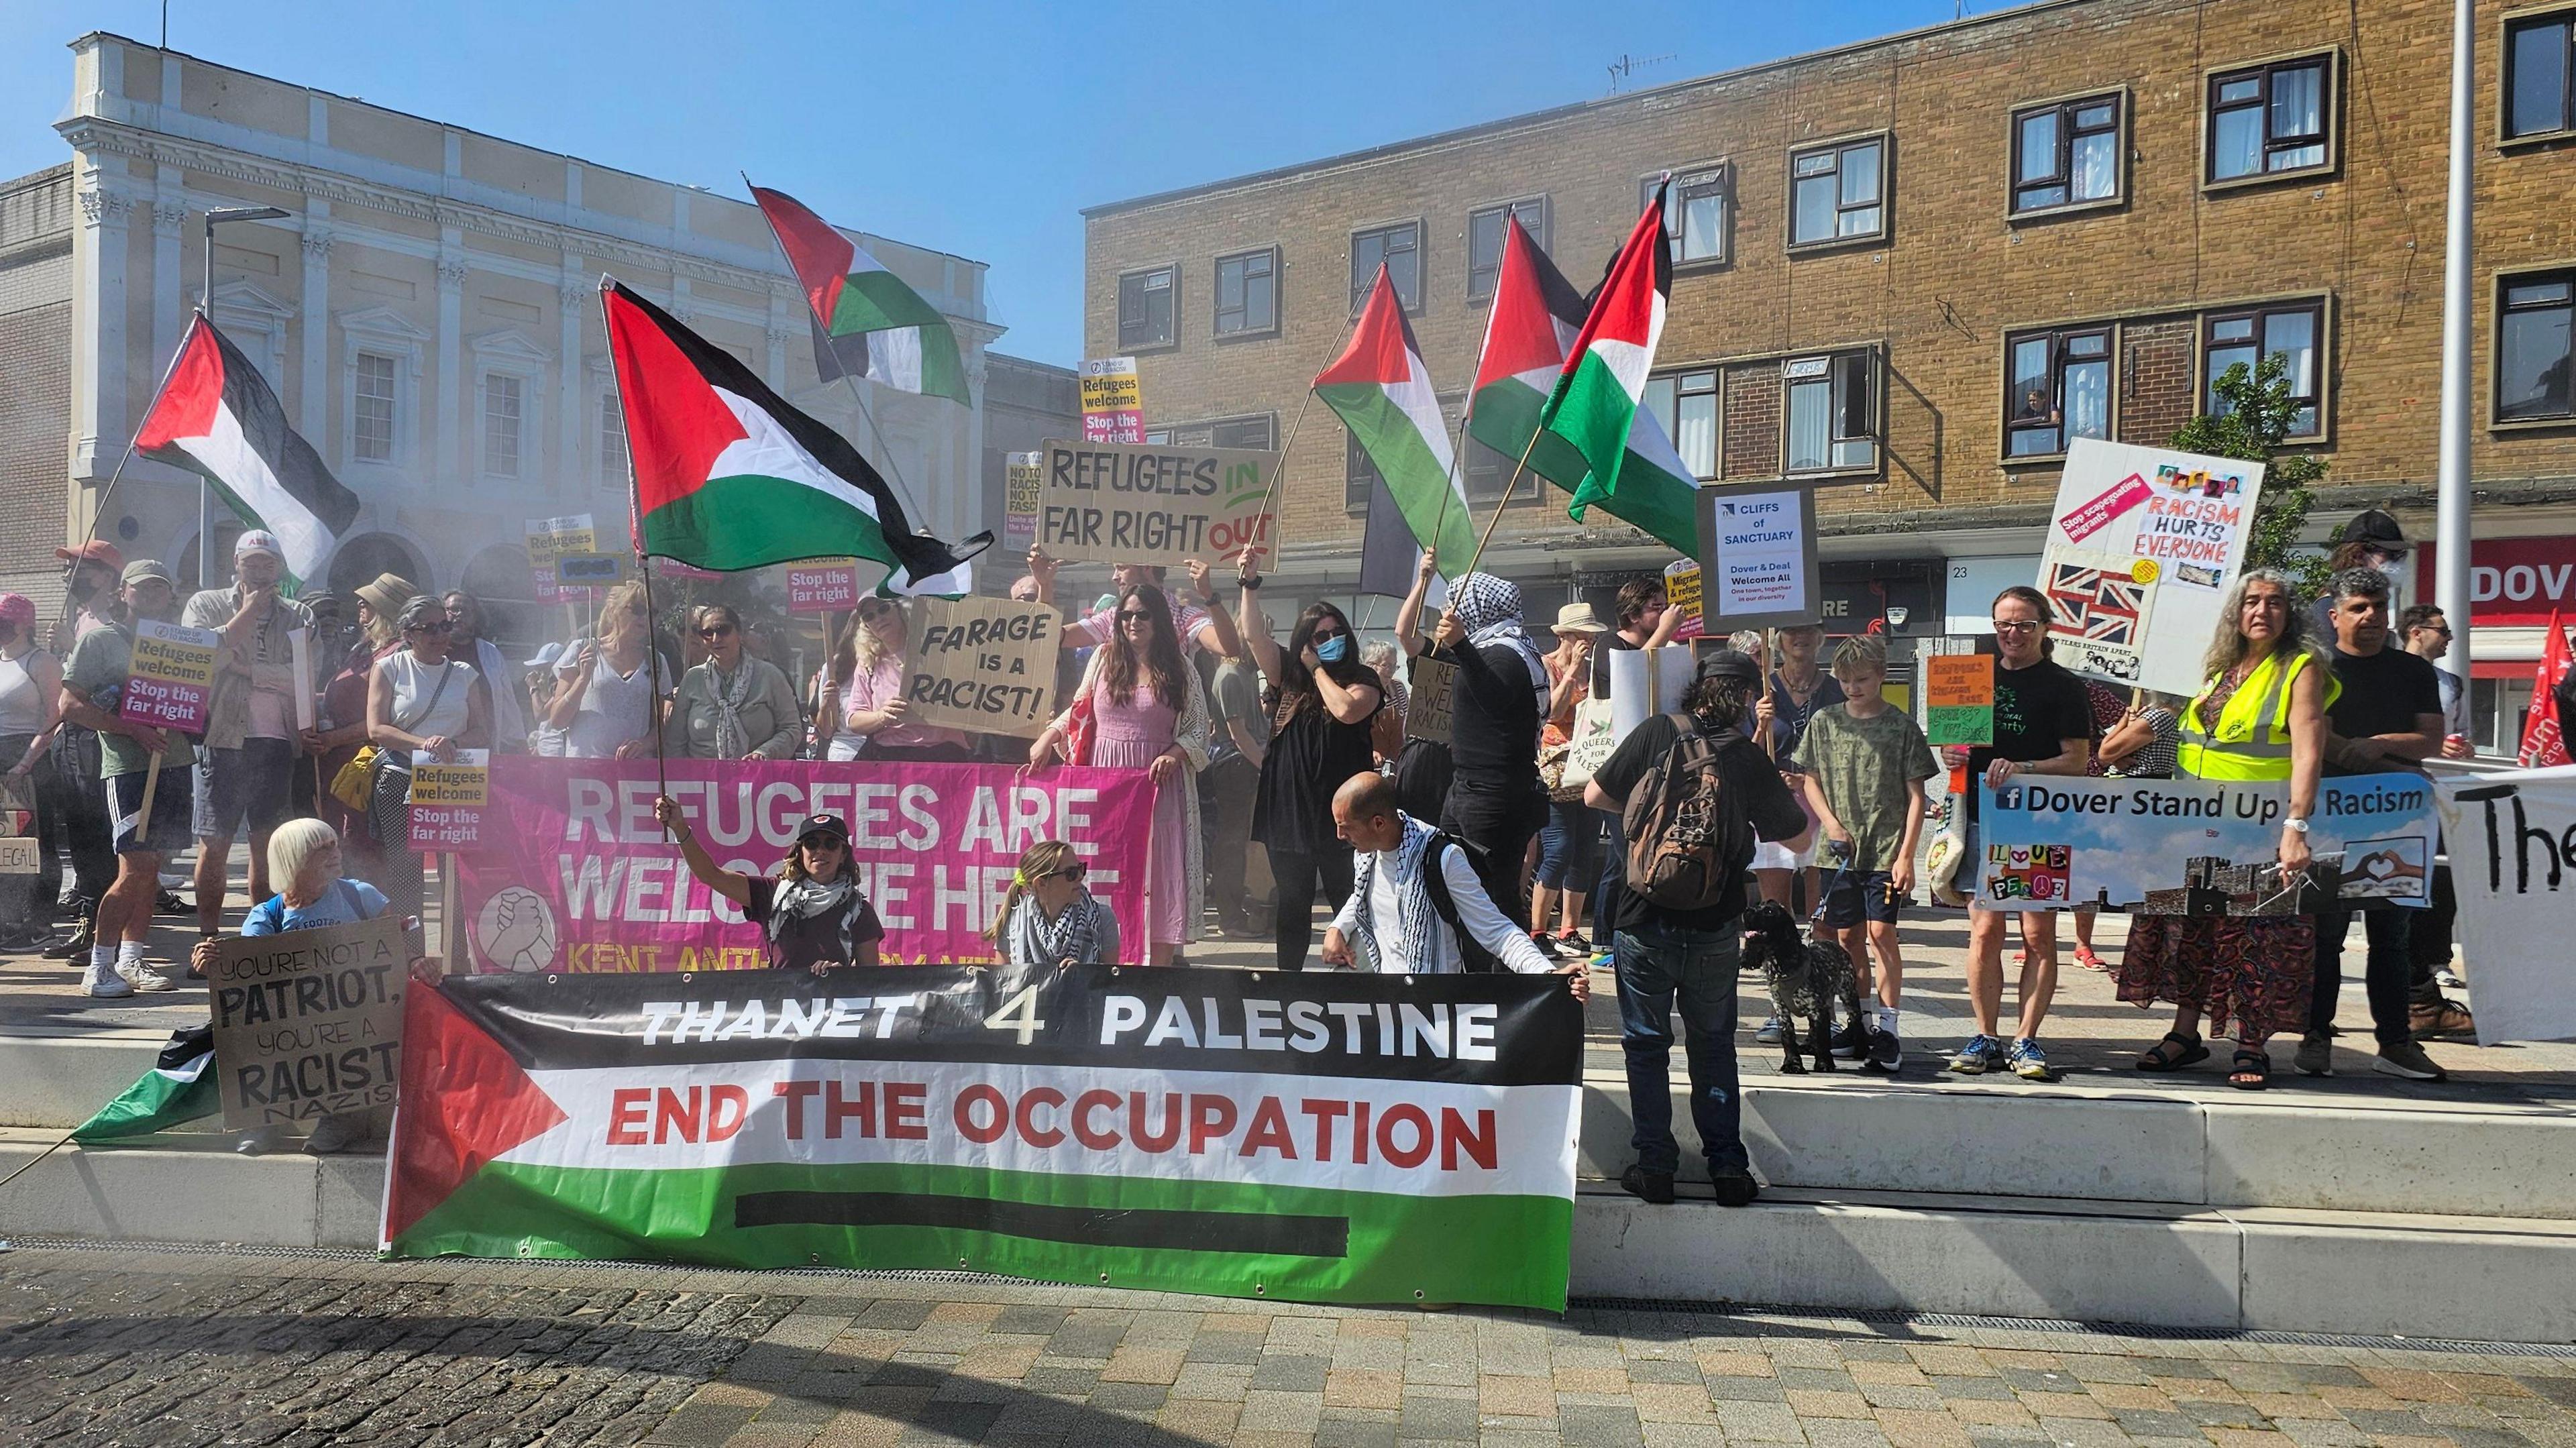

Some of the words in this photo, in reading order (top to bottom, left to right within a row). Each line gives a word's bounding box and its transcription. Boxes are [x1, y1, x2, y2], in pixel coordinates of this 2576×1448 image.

[1083, 378, 1136, 393] Refugees
[1085, 394, 1136, 408] welcome
[1087, 416, 1114, 431] Stop
[1118, 414, 1138, 427] the
[1087, 431, 1106, 443] far
[1108, 430, 1139, 444] right
[1010, 467, 1026, 478] NO
[1029, 467, 1041, 478] TO
[1051, 449, 1218, 496] REFUGEES
[1226, 460, 1260, 494] IN
[1010, 490, 1026, 500] NO
[1740, 503, 1779, 514] CLIFFS
[2062, 514, 2086, 531] Stop
[2084, 478, 2141, 516] scapegoating
[1043, 506, 1103, 547] FAR
[1111, 510, 1209, 553] RIGHT
[1209, 514, 1273, 551] OUT
[1754, 519, 1764, 528] of
[2070, 510, 2110, 539] migrants
[2155, 517, 2225, 542] HURTS
[530, 534, 592, 549] Refugees
[1725, 531, 1794, 545] SANCTUARY
[2133, 534, 2229, 563] EVERYONE
[1731, 564, 1758, 574] Dover
[1760, 563, 1767, 571] &
[1769, 562, 1791, 571] Deal
[1953, 567, 1967, 578] 23
[792, 573, 822, 588] Stop
[826, 571, 849, 584] the
[1672, 572, 1701, 587] Migrant
[1731, 575, 1776, 586] Welcome
[1778, 573, 1791, 582] All
[792, 589, 812, 602] far
[816, 587, 850, 603] right
[1670, 589, 1676, 597] &
[1764, 585, 1792, 593] together
[1684, 606, 1699, 617] here
[1823, 600, 1849, 617] RE
[170, 628, 191, 636] STAND
[178, 635, 203, 644] RACISM
[920, 613, 1052, 657] FARAGE
[138, 639, 212, 664] Refugees
[2061, 639, 2082, 648] TEARS
[2082, 643, 2109, 652] BRITAIN
[2110, 647, 2132, 657] APART
[136, 659, 206, 680] welcome
[979, 653, 1002, 671] IS
[1009, 657, 1025, 675] A
[129, 679, 168, 701] Stop
[172, 687, 199, 702] the
[908, 674, 1044, 720] RACIST!
[126, 696, 152, 712] far
[154, 702, 195, 720] right
[1582, 738, 1616, 750] QUEERS
[415, 768, 485, 786] Refugees
[415, 786, 482, 800] welcome
[2027, 786, 2123, 814] Dover
[2131, 789, 2224, 818] Stand
[2235, 792, 2279, 826] Up
[2326, 785, 2423, 816] Racism
[413, 807, 449, 826] Stop
[453, 810, 480, 824] the
[566, 778, 940, 851] REFUGEES
[959, 785, 1099, 856] ARE
[412, 826, 436, 840] far
[439, 827, 478, 844] right
[558, 854, 915, 930] WELCE
[933, 865, 1120, 937] HEE
[220, 950, 307, 981] YOU'RE
[313, 940, 365, 968] NOT
[374, 939, 392, 959] A
[567, 943, 662, 974] KENT
[218, 964, 400, 1028] PATRIOT,
[641, 995, 916, 1046] THANET
[983, 983, 1044, 1046] 4
[1100, 995, 1498, 1062] PALESTINE
[258, 1021, 350, 1057] YOU'RE
[362, 1017, 377, 1039] A
[237, 1040, 398, 1109] RACIST
[264, 1084, 392, 1124] NAZIS
[606, 1082, 750, 1146] END
[772, 1080, 928, 1140] THE
[953, 1083, 1498, 1171] OCCUPATION
